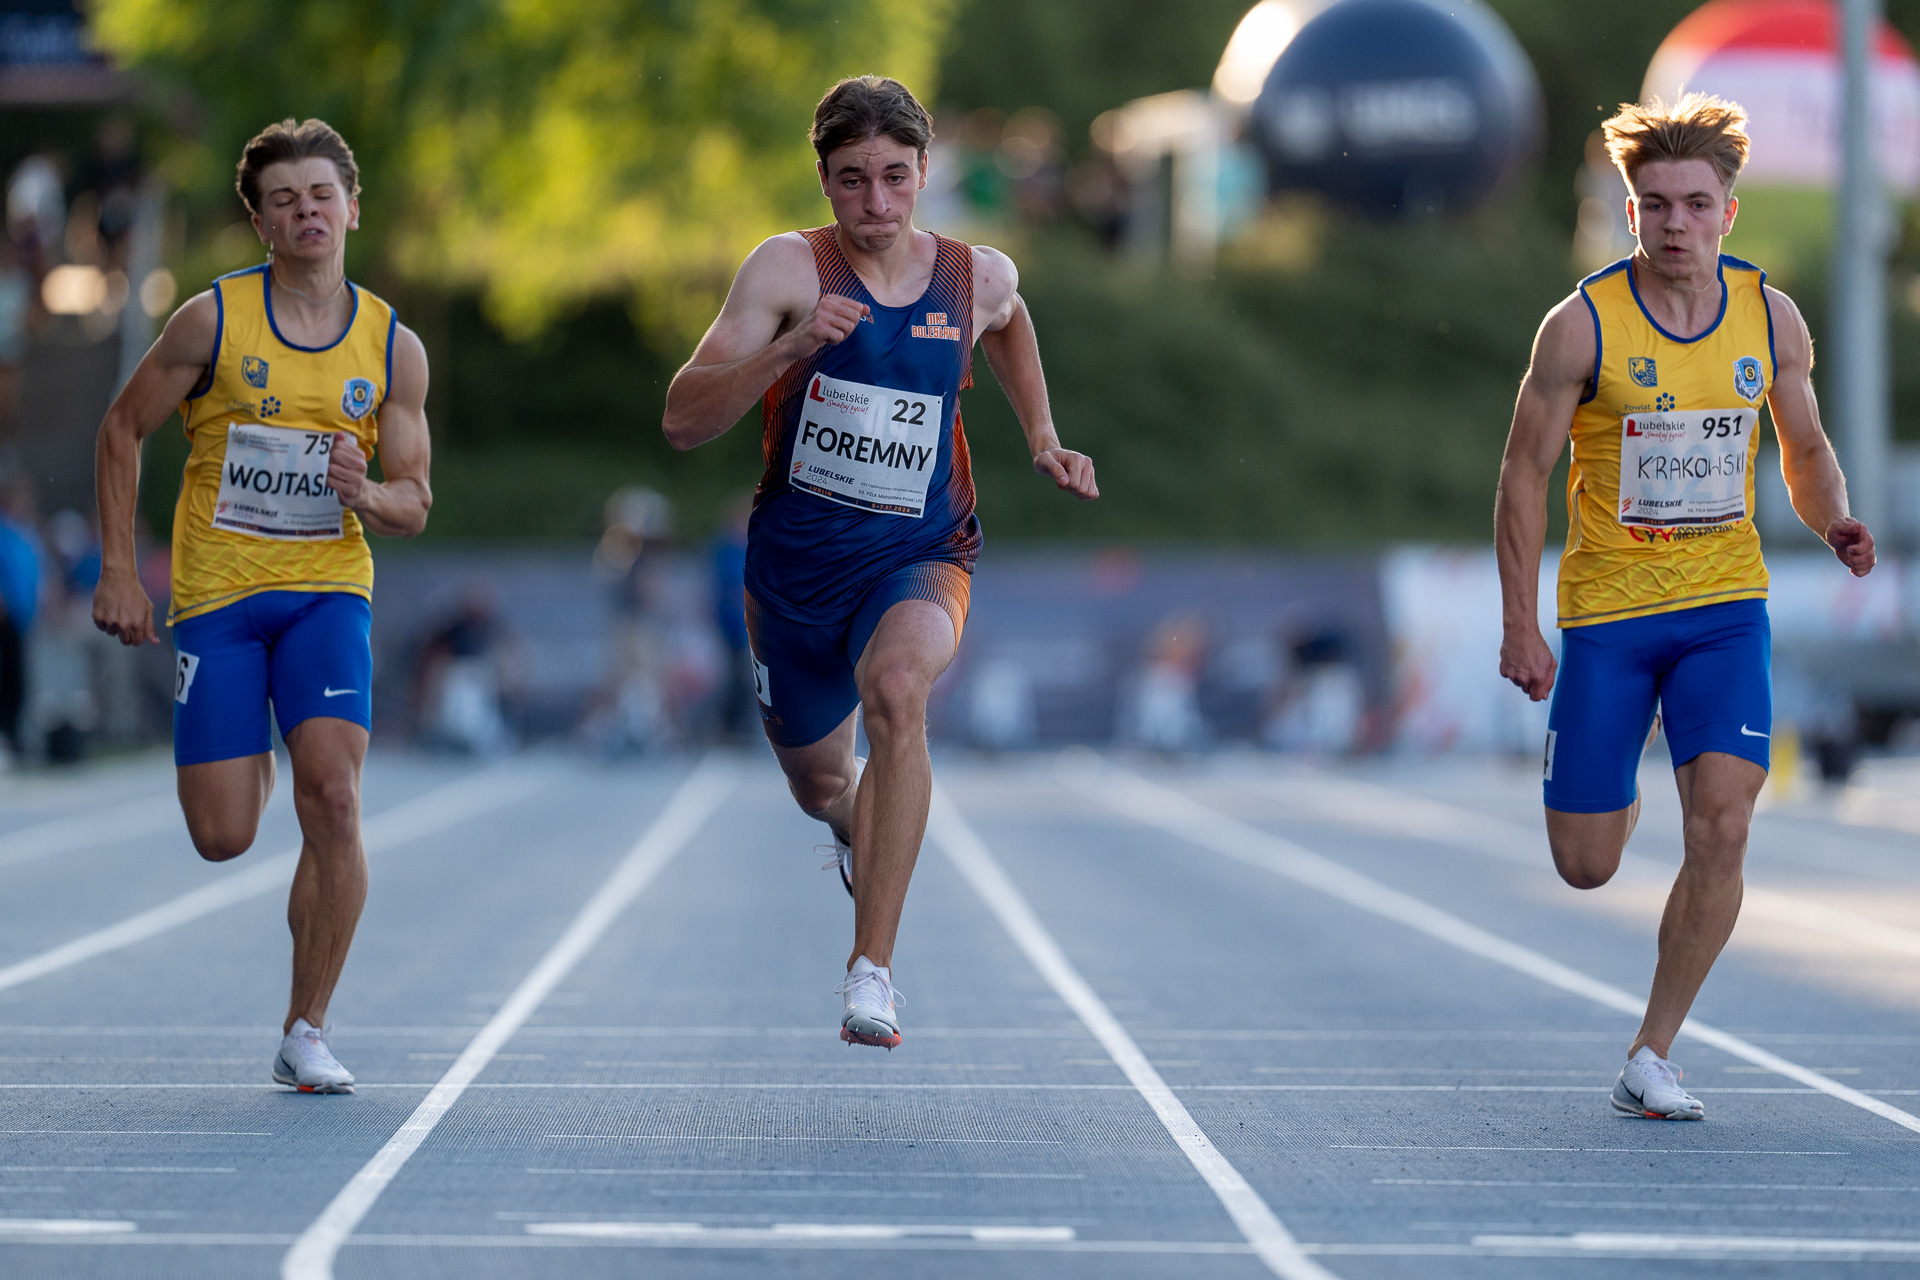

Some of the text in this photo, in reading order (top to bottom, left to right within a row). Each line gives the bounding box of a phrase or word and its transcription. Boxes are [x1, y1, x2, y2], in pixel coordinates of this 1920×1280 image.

[926, 312, 948, 326] MKS
[891, 399, 926, 426] 22
[1702, 415, 1743, 440] 951
[801, 420, 933, 472] FOREMNY
[808, 465, 856, 485] LUBELSKIE
[1637, 451, 1745, 480] KRAKOWSKI
[805, 472, 828, 485] 2024
[1638, 499, 1683, 508] LUBELSKIE
[176, 656, 189, 698] 6
